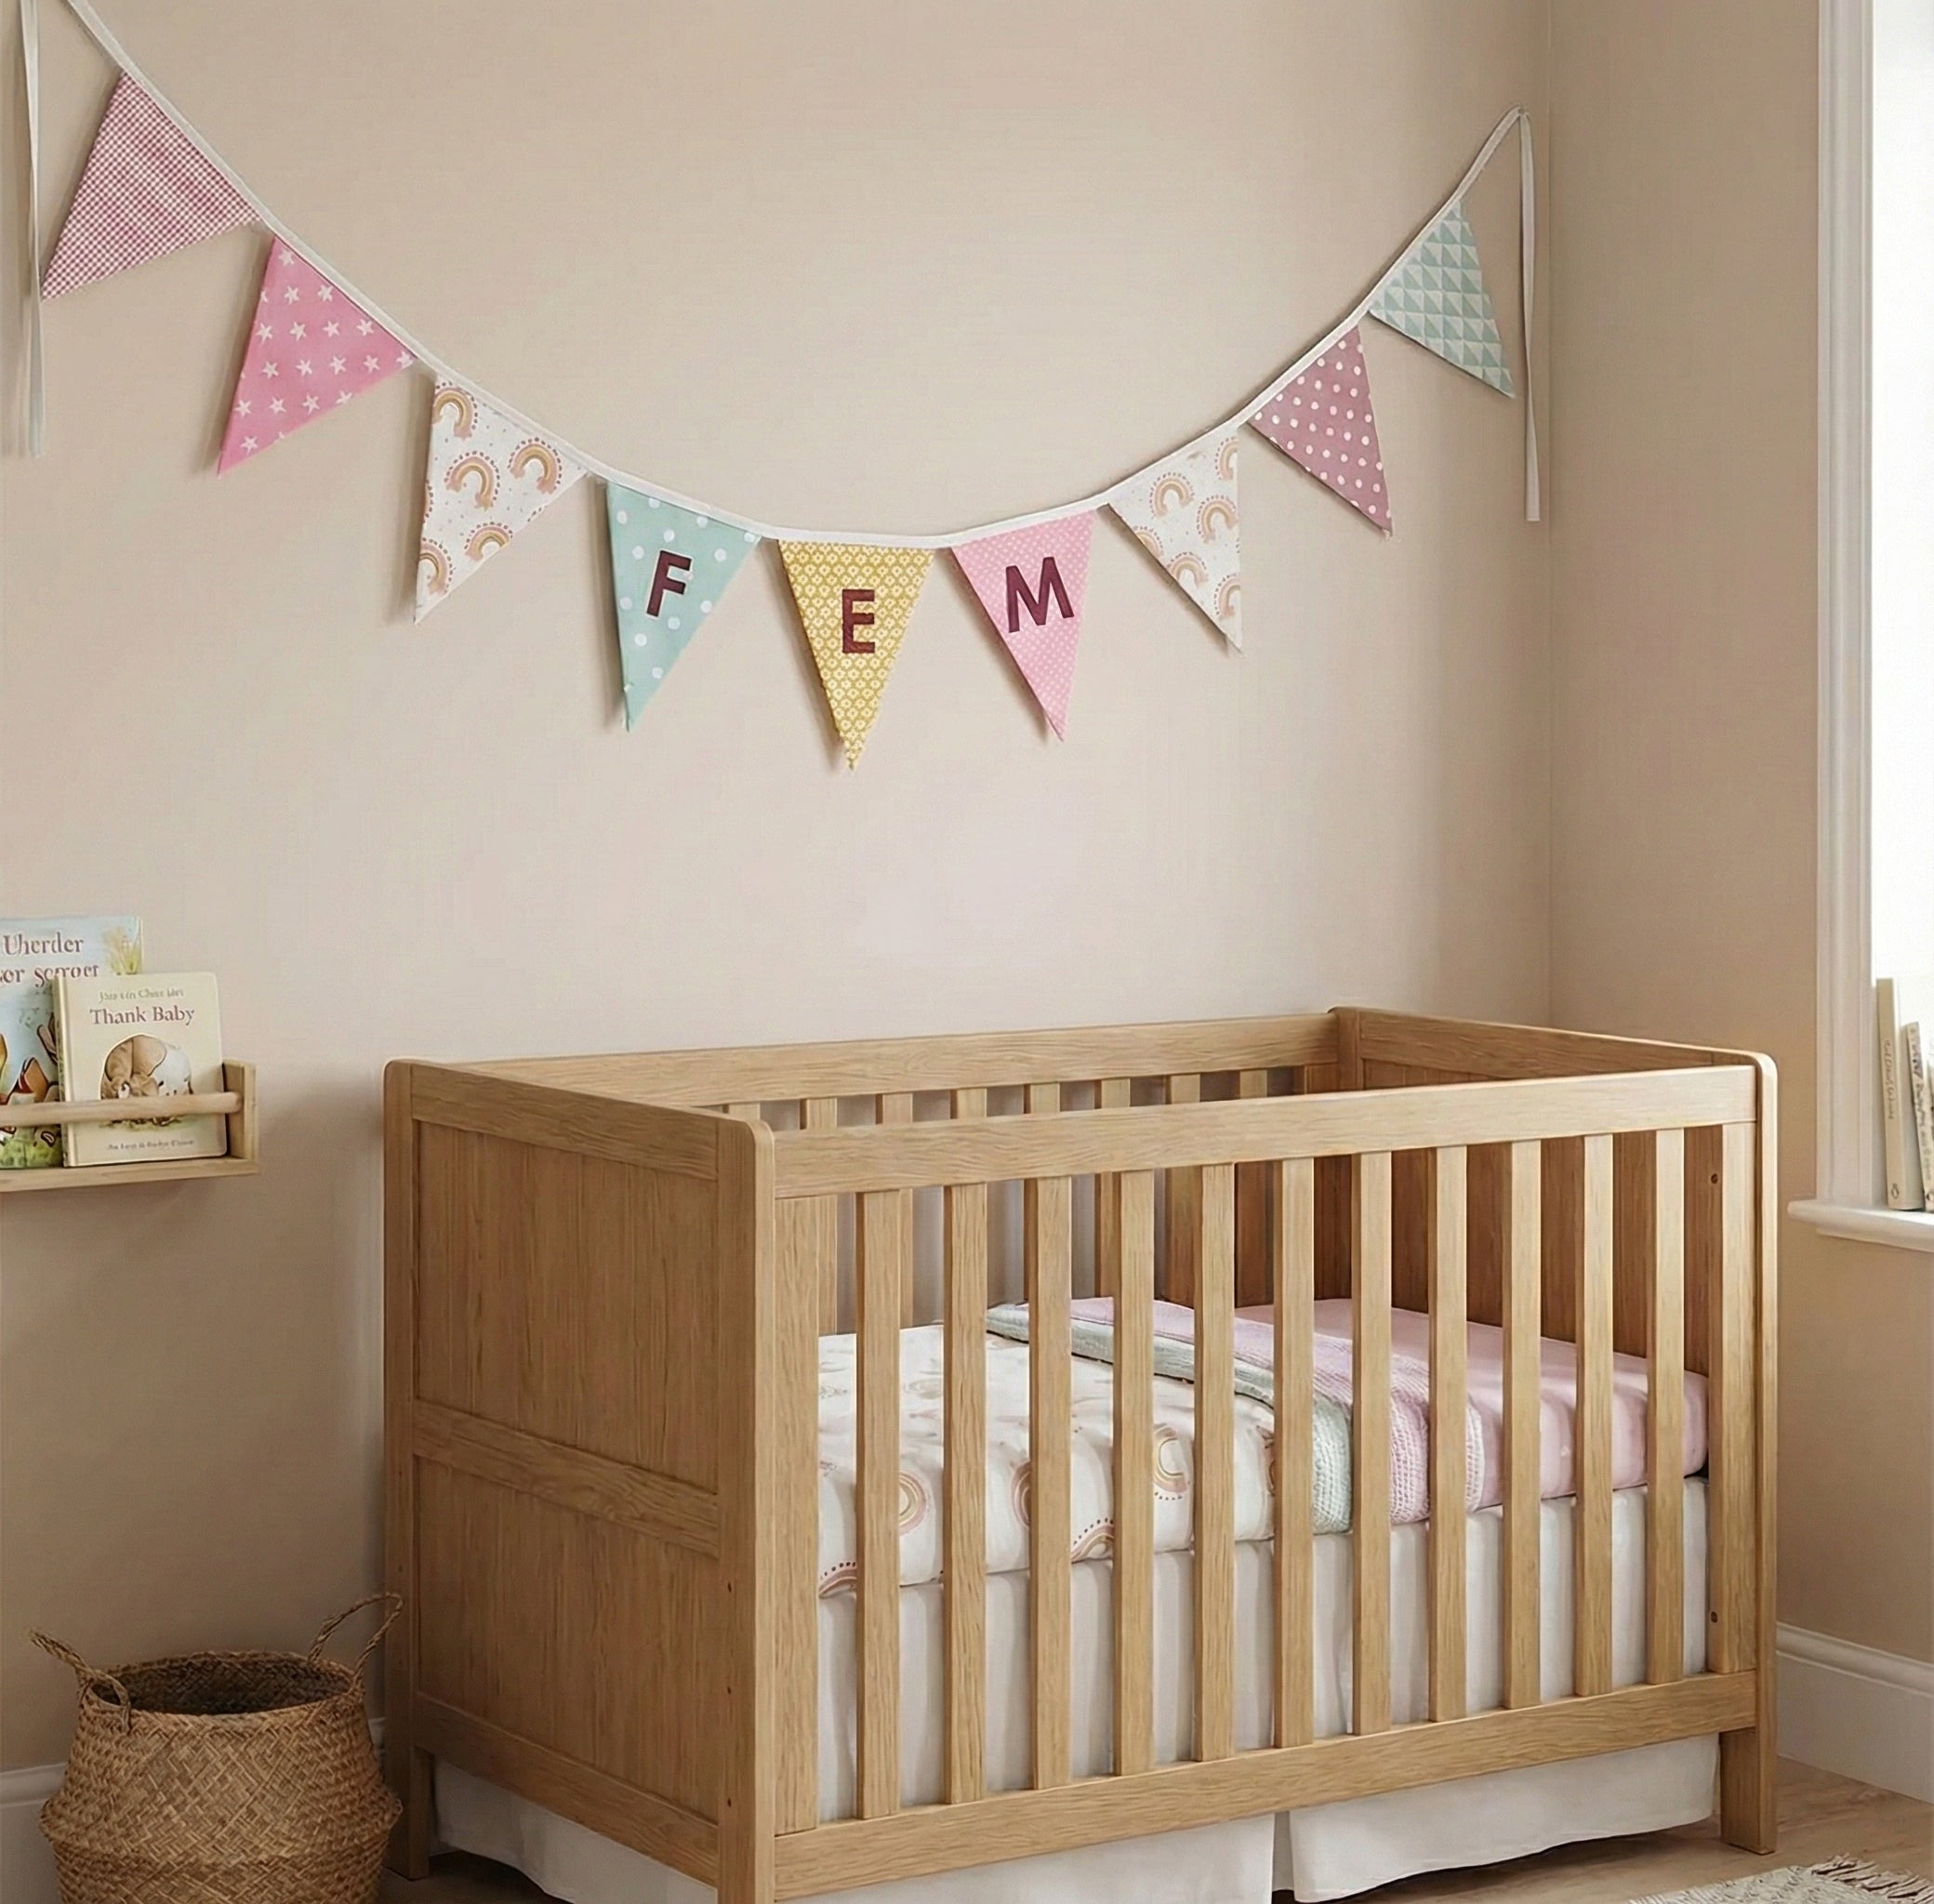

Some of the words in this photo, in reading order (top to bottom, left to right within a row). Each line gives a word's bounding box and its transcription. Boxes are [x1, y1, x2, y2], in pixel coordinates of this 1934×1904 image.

[646, 549, 693, 618] F
[841, 588, 876, 654] E
[1005, 556, 1075, 633] M
[90, 1006, 147, 1025] Thank
[152, 1004, 195, 1026] Baby
